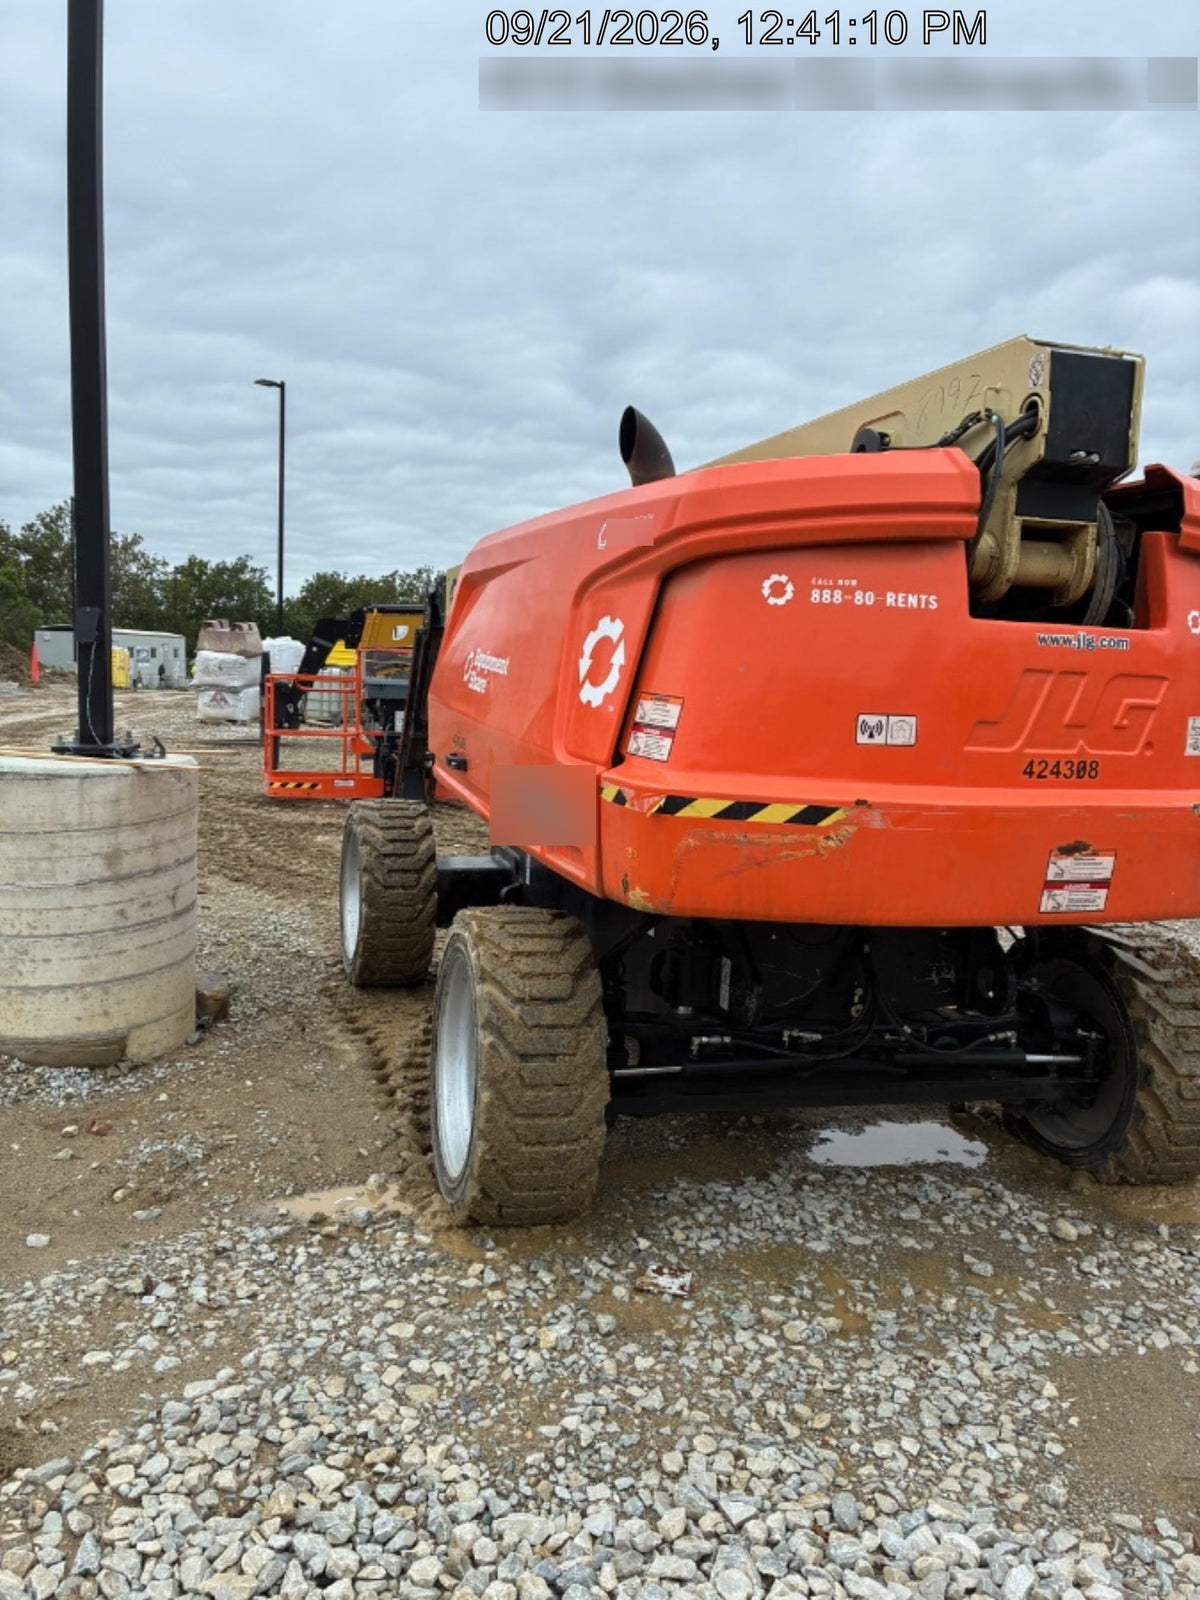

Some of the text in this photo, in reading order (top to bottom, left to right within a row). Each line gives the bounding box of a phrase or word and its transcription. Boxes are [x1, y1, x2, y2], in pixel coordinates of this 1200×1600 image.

[811, 577, 833, 586] CALL
[810, 589, 938, 610] 888-80-RENTS
[1037, 632, 1130, 650] www.jlg.com
[964, 668, 1169, 756] JLG
[1022, 759, 1100, 779] 424308
